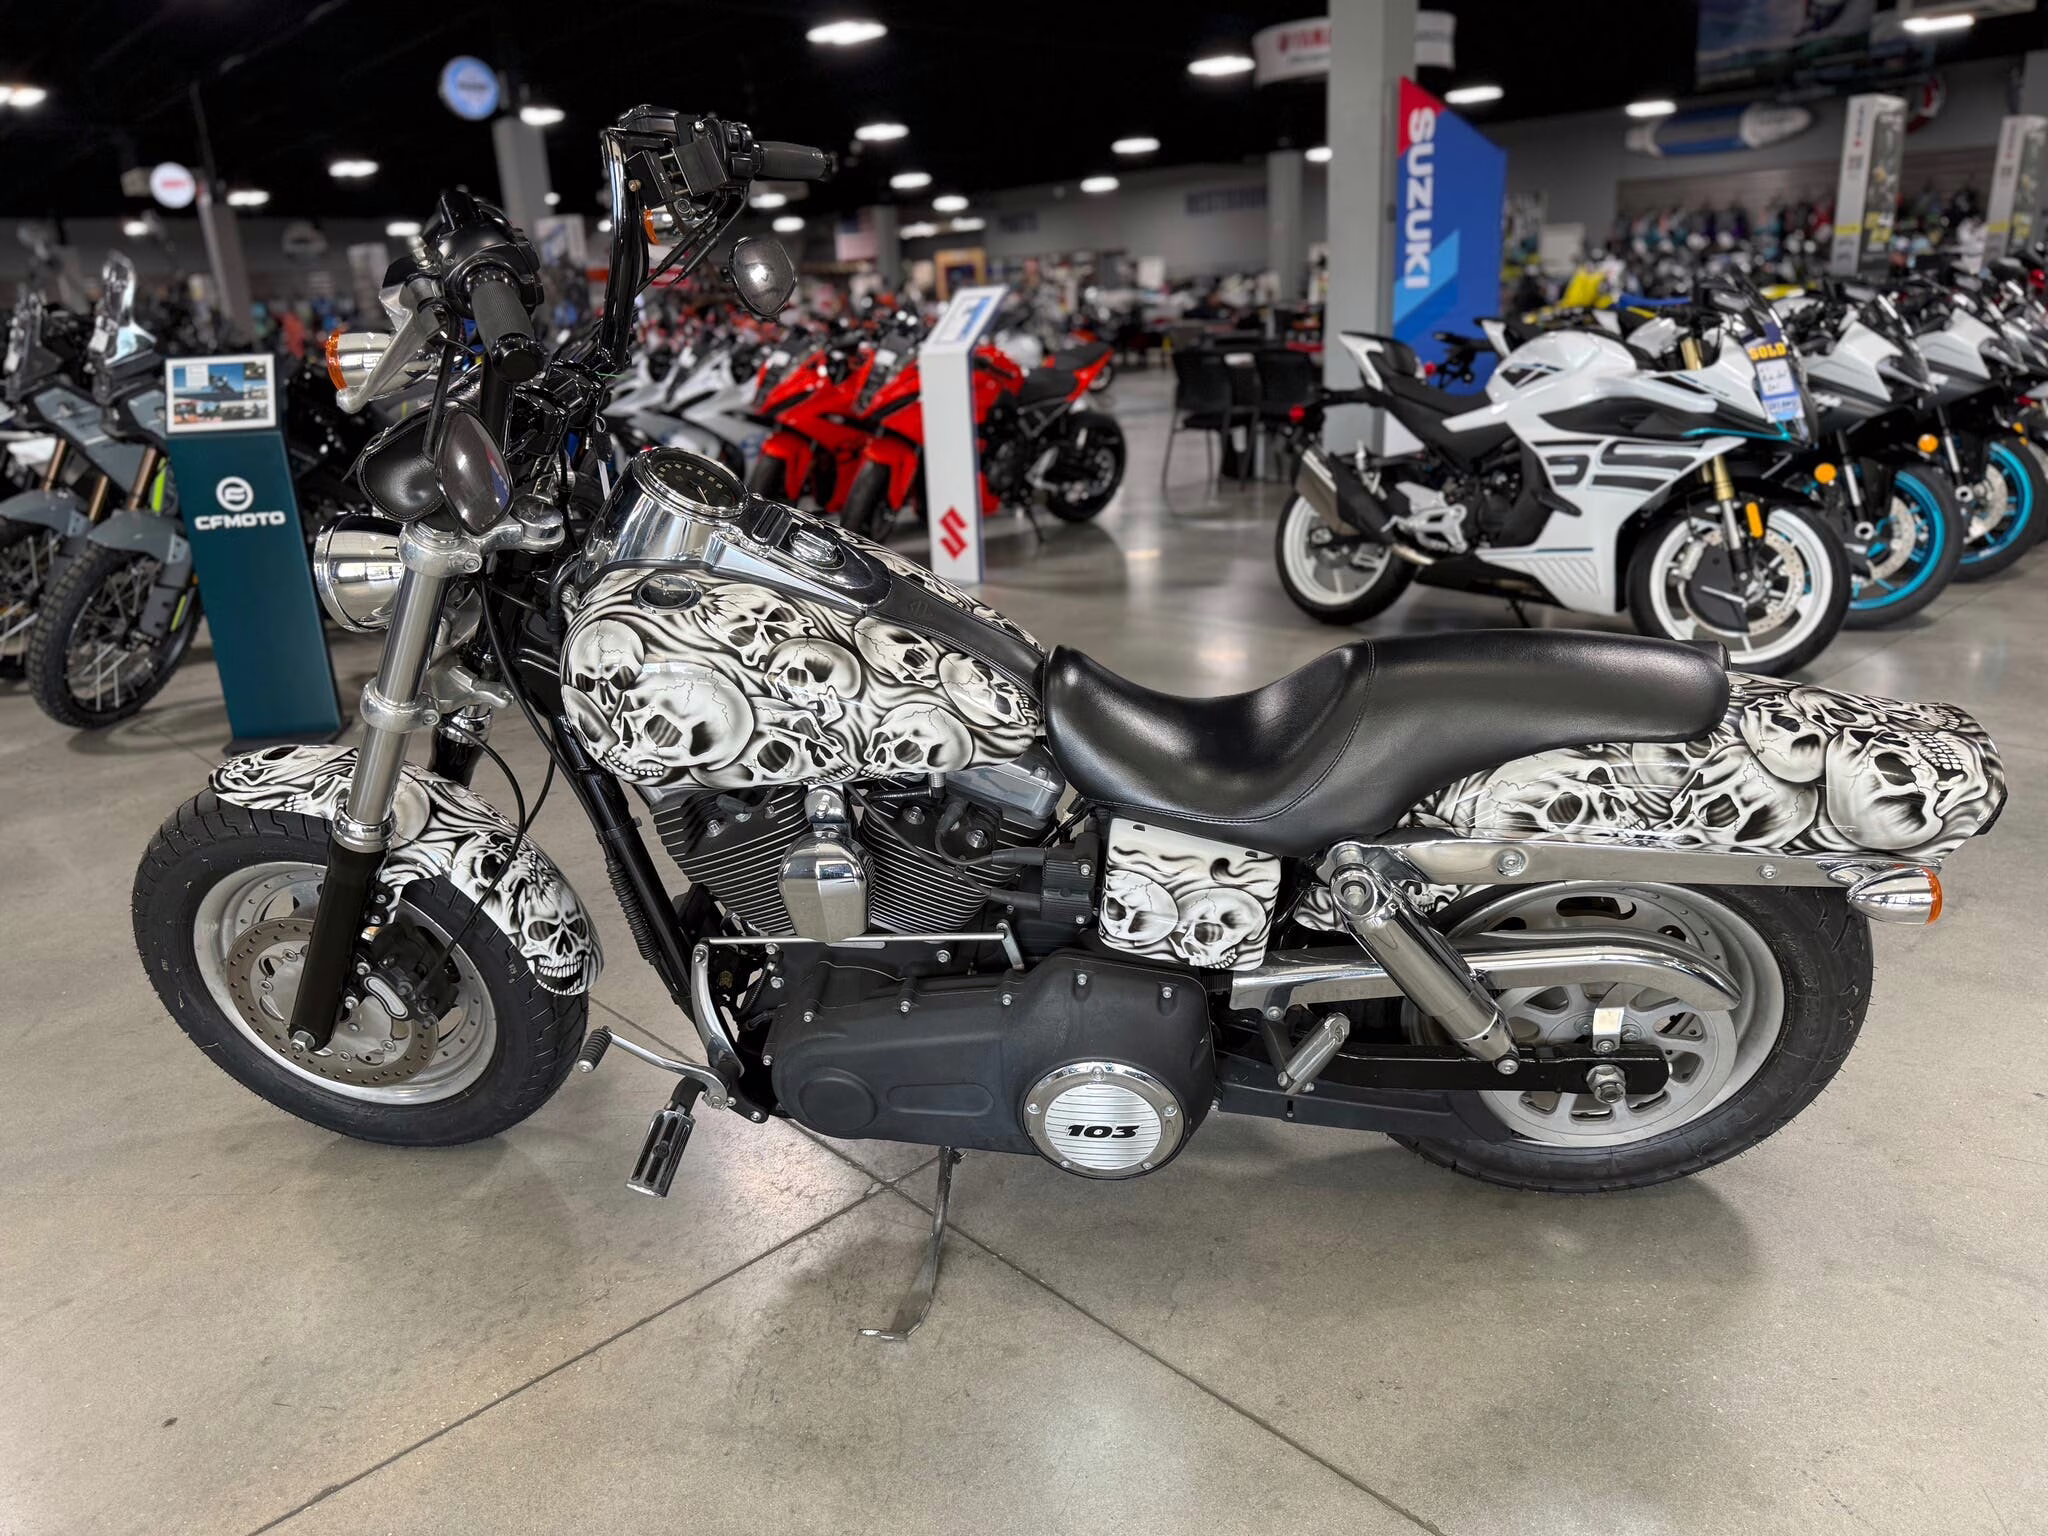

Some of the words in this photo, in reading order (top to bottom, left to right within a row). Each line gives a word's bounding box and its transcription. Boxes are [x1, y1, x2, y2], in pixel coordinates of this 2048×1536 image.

[1404, 106, 1436, 289] SUZUKI
[1748, 341, 1787, 361] SOLD
[194, 510, 286, 531] CFMOTO
[1067, 1124, 1140, 1139] 103
